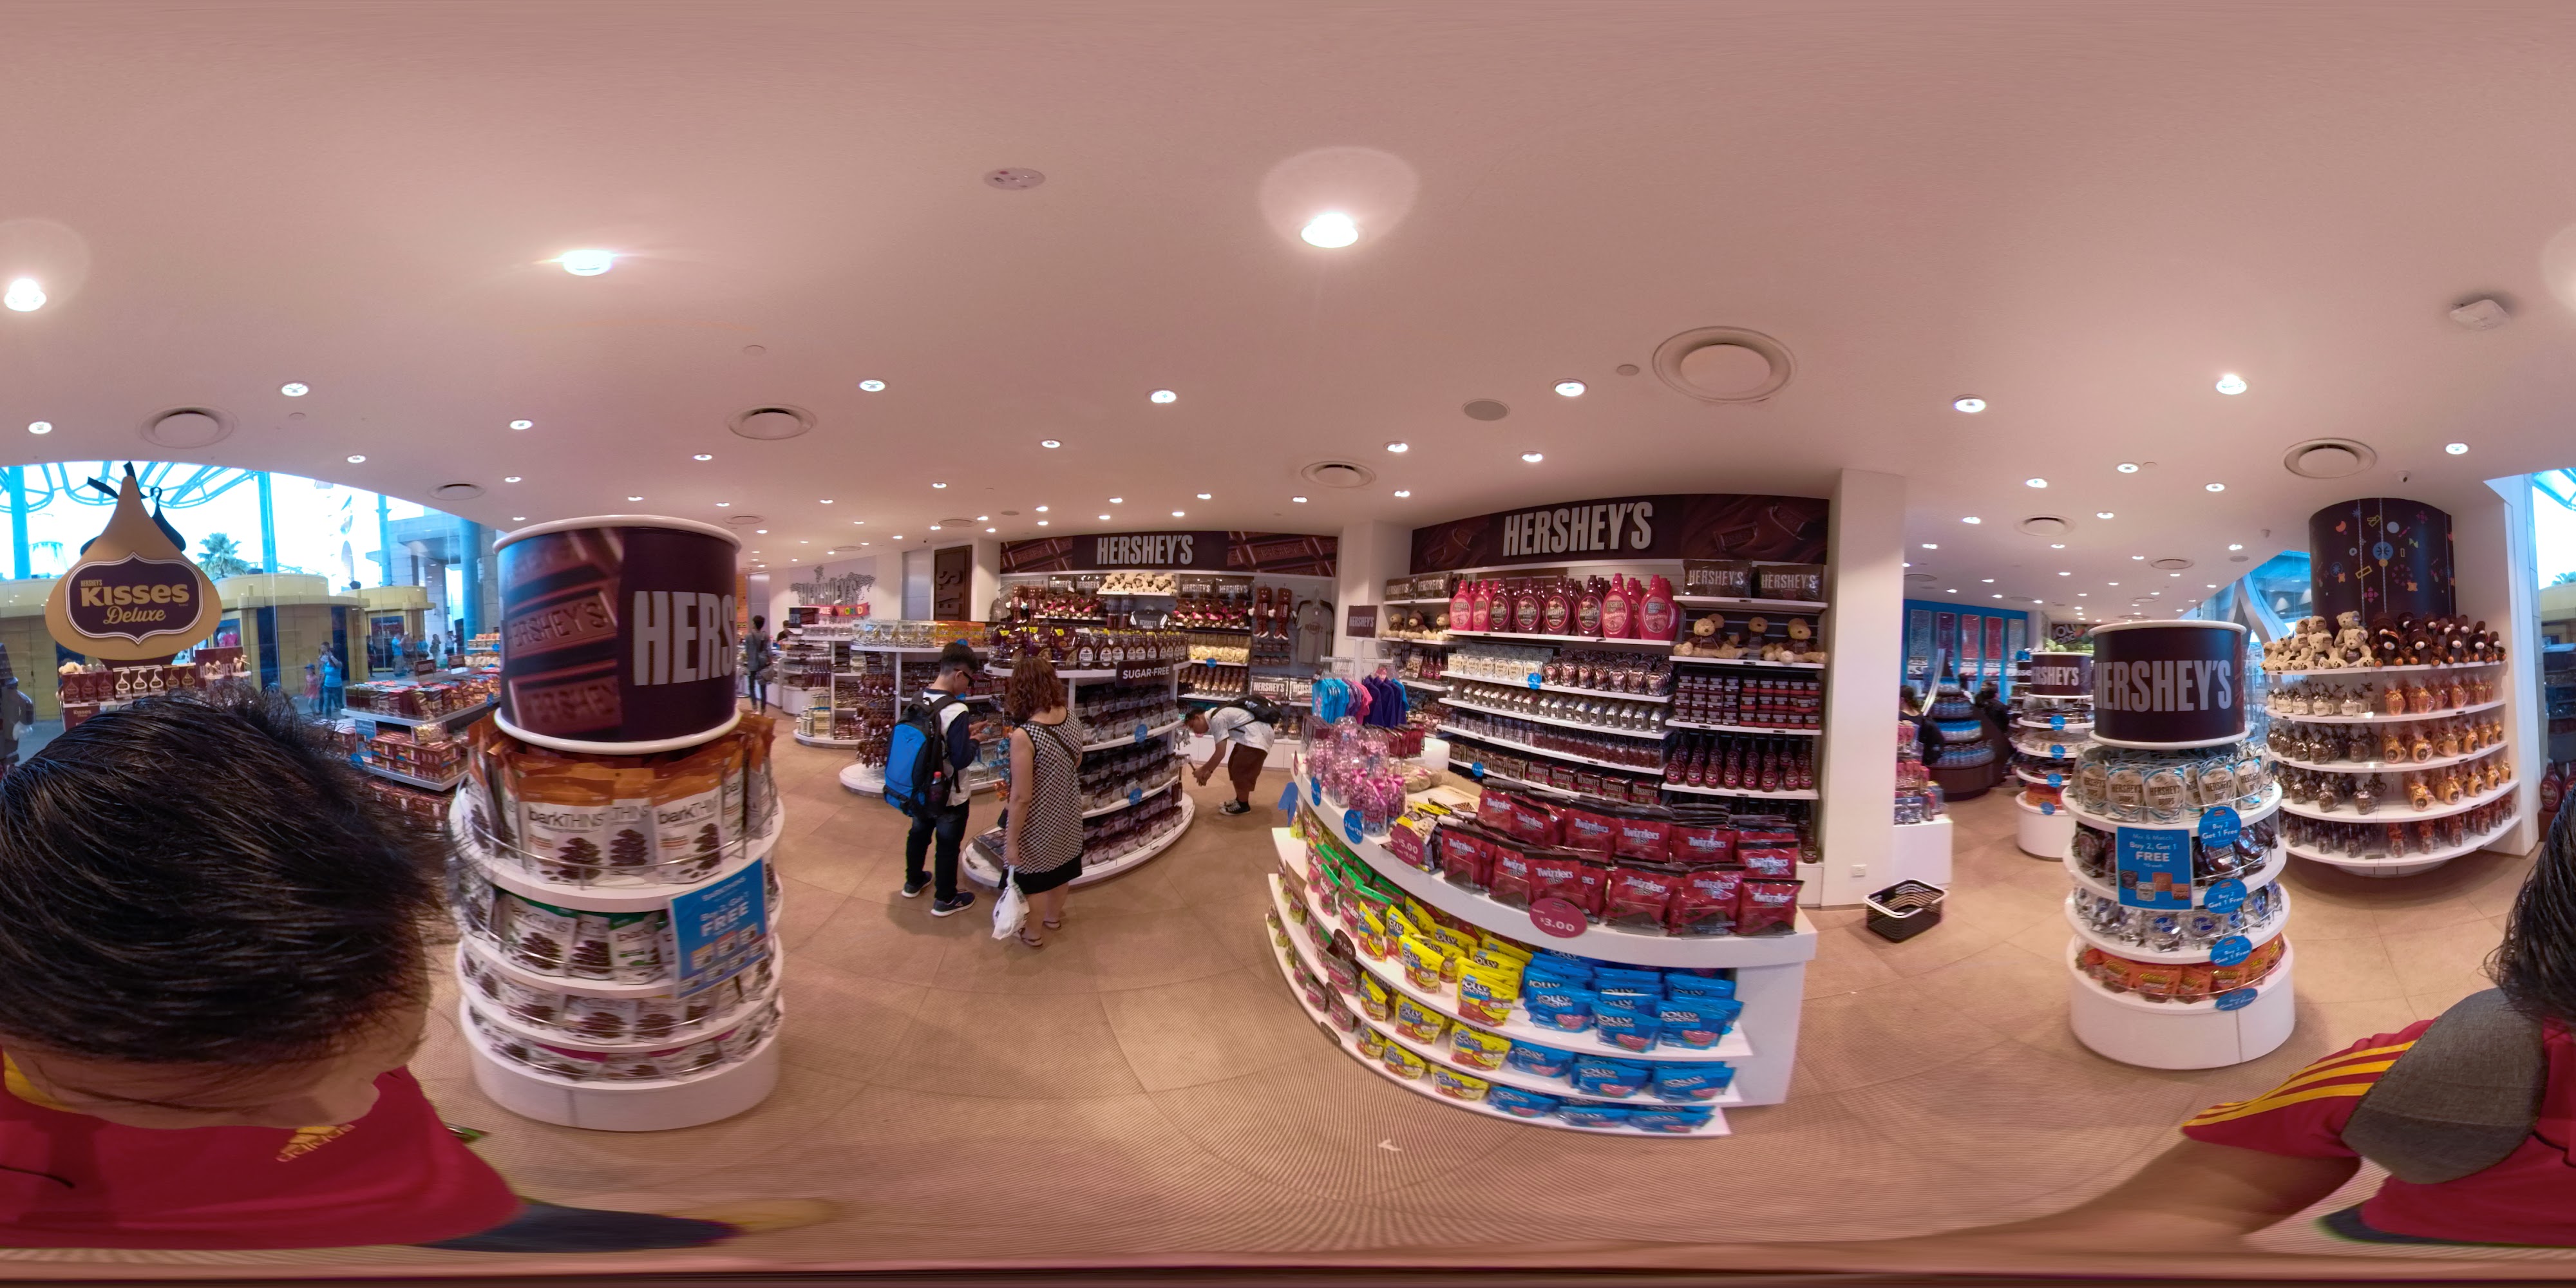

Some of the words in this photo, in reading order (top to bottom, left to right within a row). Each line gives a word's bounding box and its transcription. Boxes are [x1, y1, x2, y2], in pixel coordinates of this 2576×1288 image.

[1502, 501, 1653, 557] HERSHEY'S
[1097, 535, 1193, 565] HERSHEY'S
[1689, 569, 1744, 585] HERSHEY'S
[1761, 574, 1817, 589] HERSHEY'S
[1076, 580, 1099, 589] HERSHEY'S
[1182, 584, 1211, 592] HERSHEY'S
[1219, 585, 1248, 593] HERSHEY'S
[1418, 579, 1444, 591] HERSHEY'S
[80, 584, 190, 607] Kisses
[800, 580, 857, 606] HERSHEY'S
[103, 606, 166, 624] Deluxe
[1349, 616, 1374, 628] HERSHEY'S
[634, 591, 736, 686] HERS
[1122, 667, 1170, 679] SUGAR-FREE
[1253, 682, 1285, 693] HERSHEY'S
[1292, 684, 1312, 693] HERSH
[2095, 659, 2232, 712] HERSHEY'S
[1529, 765, 1549, 776] HERSHEY'S
[1553, 770, 1573, 782] HERSHEY'S
[1578, 773, 1600, 786] HERSHEY'S
[1603, 781, 1625, 793] HERSHEY'S
[1634, 785, 1658, 797] HERSHEY'S
[2112, 784, 2143, 793] HERSHEY'S
[2150, 785, 2181, 795] HERSHEY'S
[612, 806, 649, 820] THINS
[1516, 812, 1544, 829] Twizzlers
[1575, 817, 1609, 833] Twizzlers
[1623, 827, 1660, 840] Twizzlers
[1398, 838, 1419, 855] $5.00
[1448, 838, 1475, 854] Twizzlers
[1688, 836, 1727, 849] Twizzlers
[2129, 842, 2144, 850] Buy
[2136, 851, 2170, 862] FREE
[1535, 867, 1573, 879] Twizzlers
[1625, 876, 1666, 894] Twizzlers
[701, 902, 750, 937] FREE
[1540, 917, 1575, 932] $3.00
[1528, 980, 1560, 988] JOLLY
